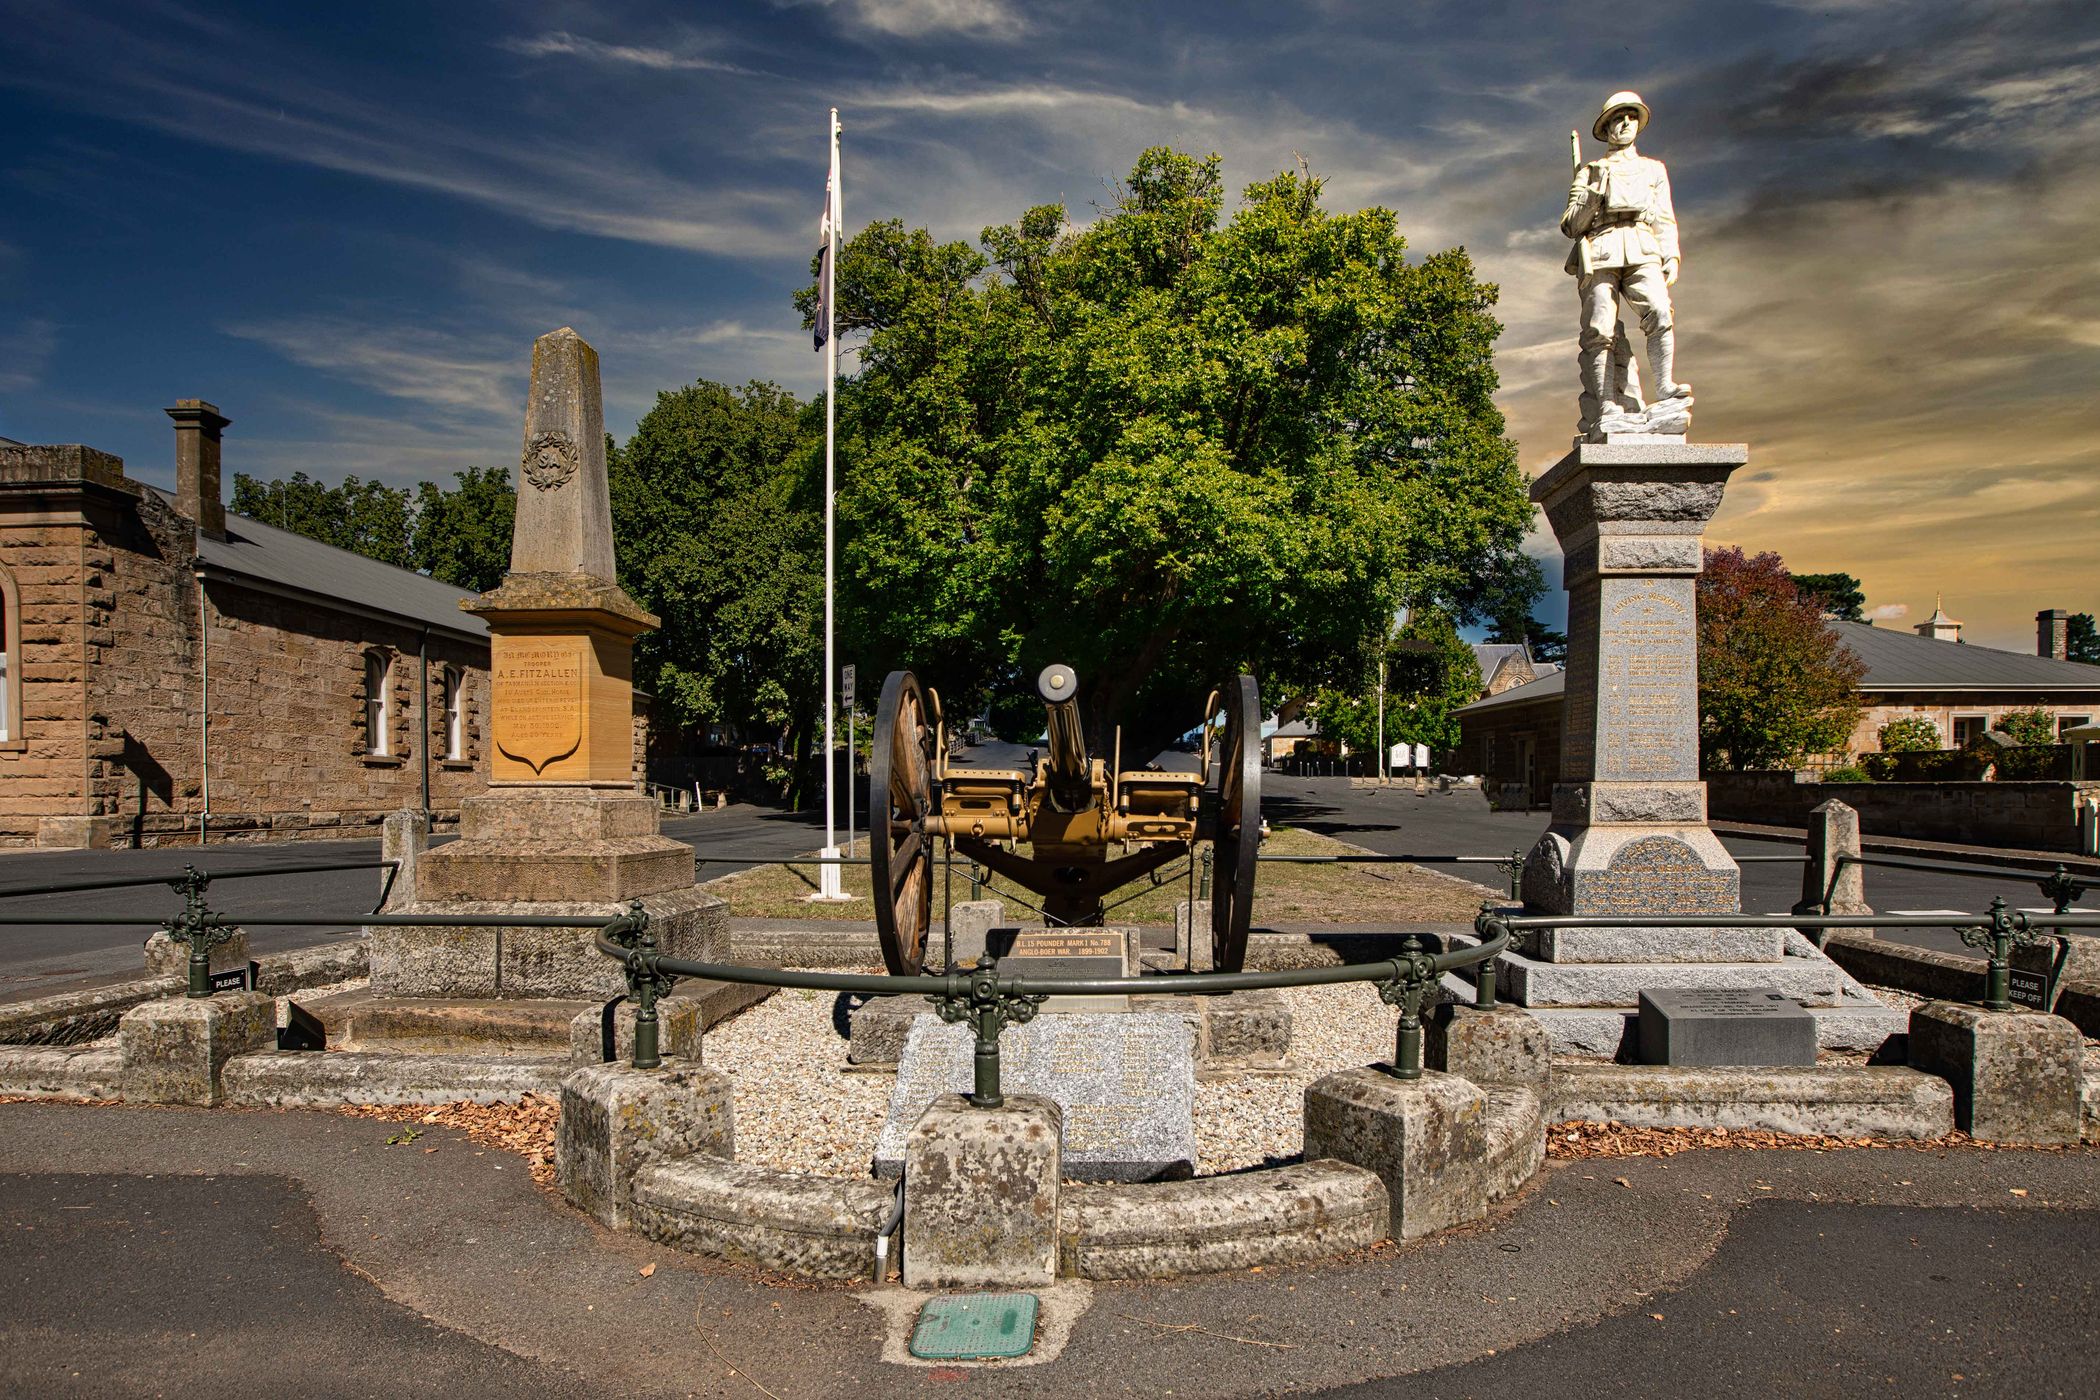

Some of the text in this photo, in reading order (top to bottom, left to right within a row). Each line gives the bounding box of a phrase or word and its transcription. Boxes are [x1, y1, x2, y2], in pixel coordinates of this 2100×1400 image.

[1611, 591, 1688, 615] LOVING MEMORY
[844, 669, 853, 680] ONE
[844, 682, 853, 692] WAY
[1626, 840, 1689, 859] ERECTED
[1612, 864, 1701, 874] LOVING MEMORY
[1018, 948, 1056, 956] ANGLO-BOER
[216, 977, 240, 989] PLEASE
[2012, 978, 2039, 991] PLEASE
[2008, 990, 2042, 1003] KEEP OFF
